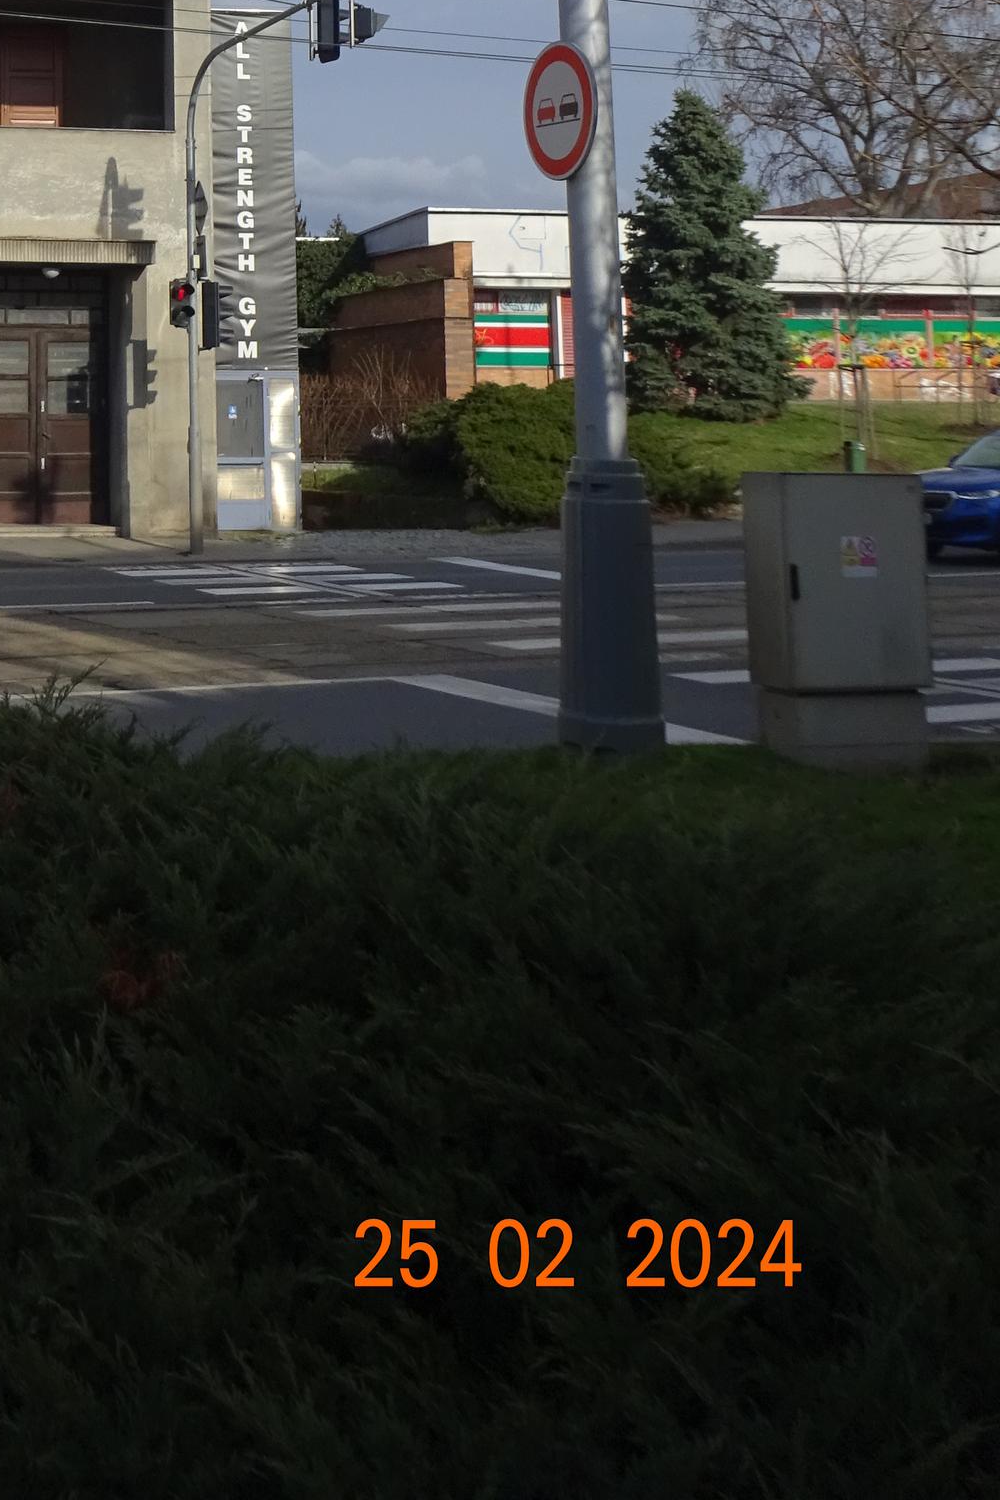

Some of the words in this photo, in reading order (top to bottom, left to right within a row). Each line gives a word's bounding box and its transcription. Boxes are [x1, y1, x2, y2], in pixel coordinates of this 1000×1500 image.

[234, 21, 251, 80] ALL
[237, 104, 255, 272] STRENGTH
[238, 297, 258, 359] GYM
